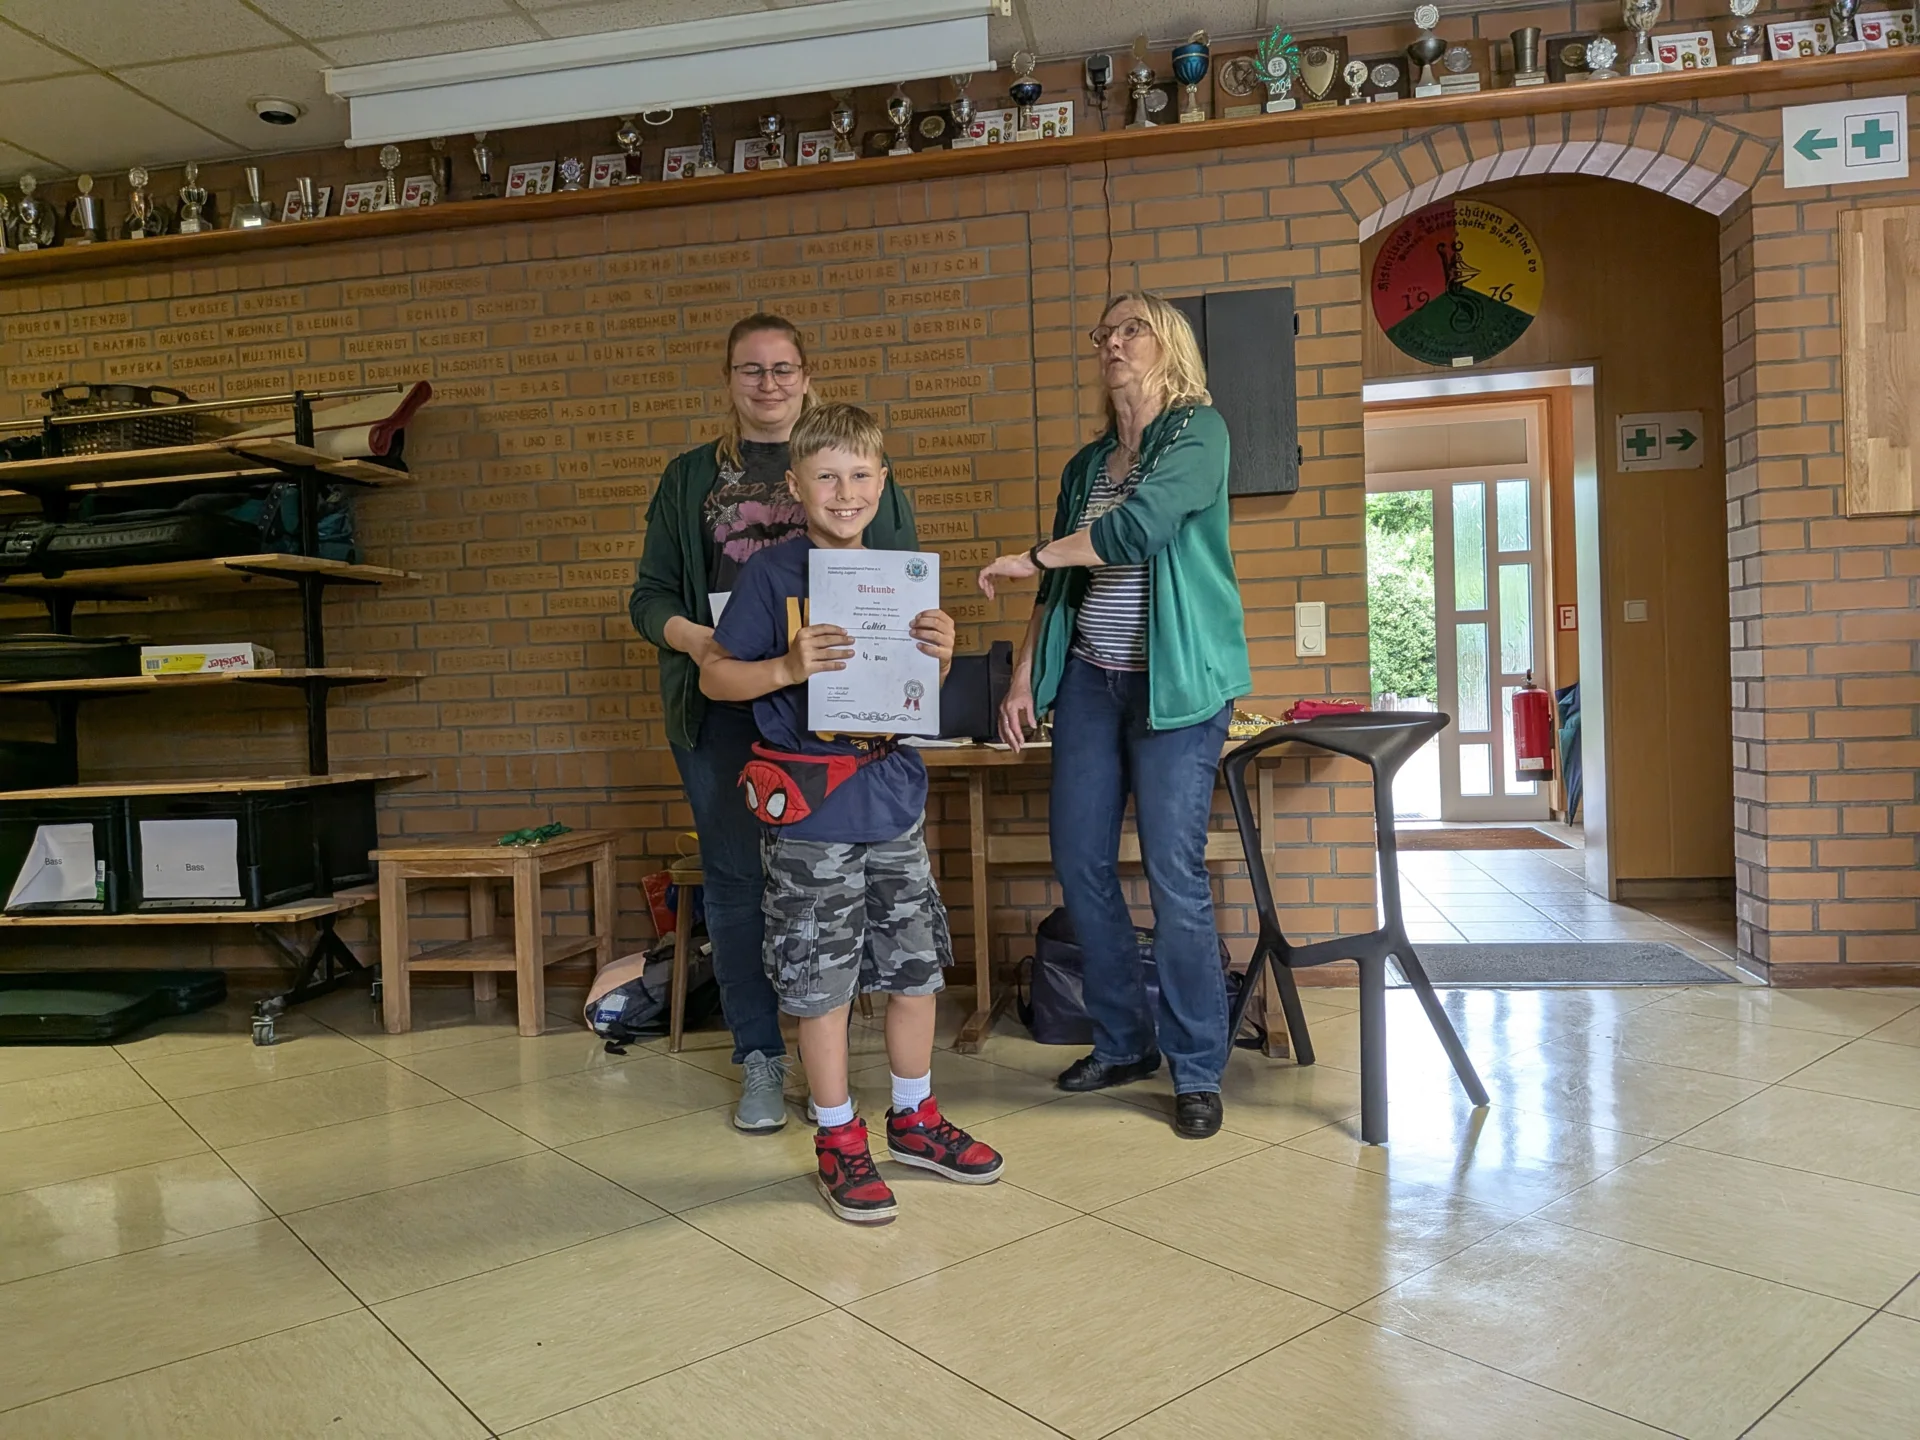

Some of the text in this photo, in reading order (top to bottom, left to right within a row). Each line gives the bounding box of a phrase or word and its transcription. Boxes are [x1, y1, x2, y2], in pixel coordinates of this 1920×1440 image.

[1270, 79, 1291, 94] 2004
[912, 257, 978, 275] NITSCH
[406, 306, 458, 321] SCHILD
[477, 299, 537, 314] SCHMIDT
[913, 317, 982, 335] GERBING
[915, 375, 982, 391] BARTHOLD
[587, 429, 636, 444] WIESE
[895, 463, 972, 480] MICHELMANN
[918, 490, 993, 506] PREISSLER
[568, 568, 630, 583] BRANDES
[857, 584, 896, 594] Urkunde
[1562, 609, 1572, 626] F
[861, 621, 887, 630] Collin
[207, 654, 249, 669] Twister
[862, 651, 871, 661] 4.
[45, 857, 63, 866] Bass
[155, 863, 205, 872] 1. Bass
